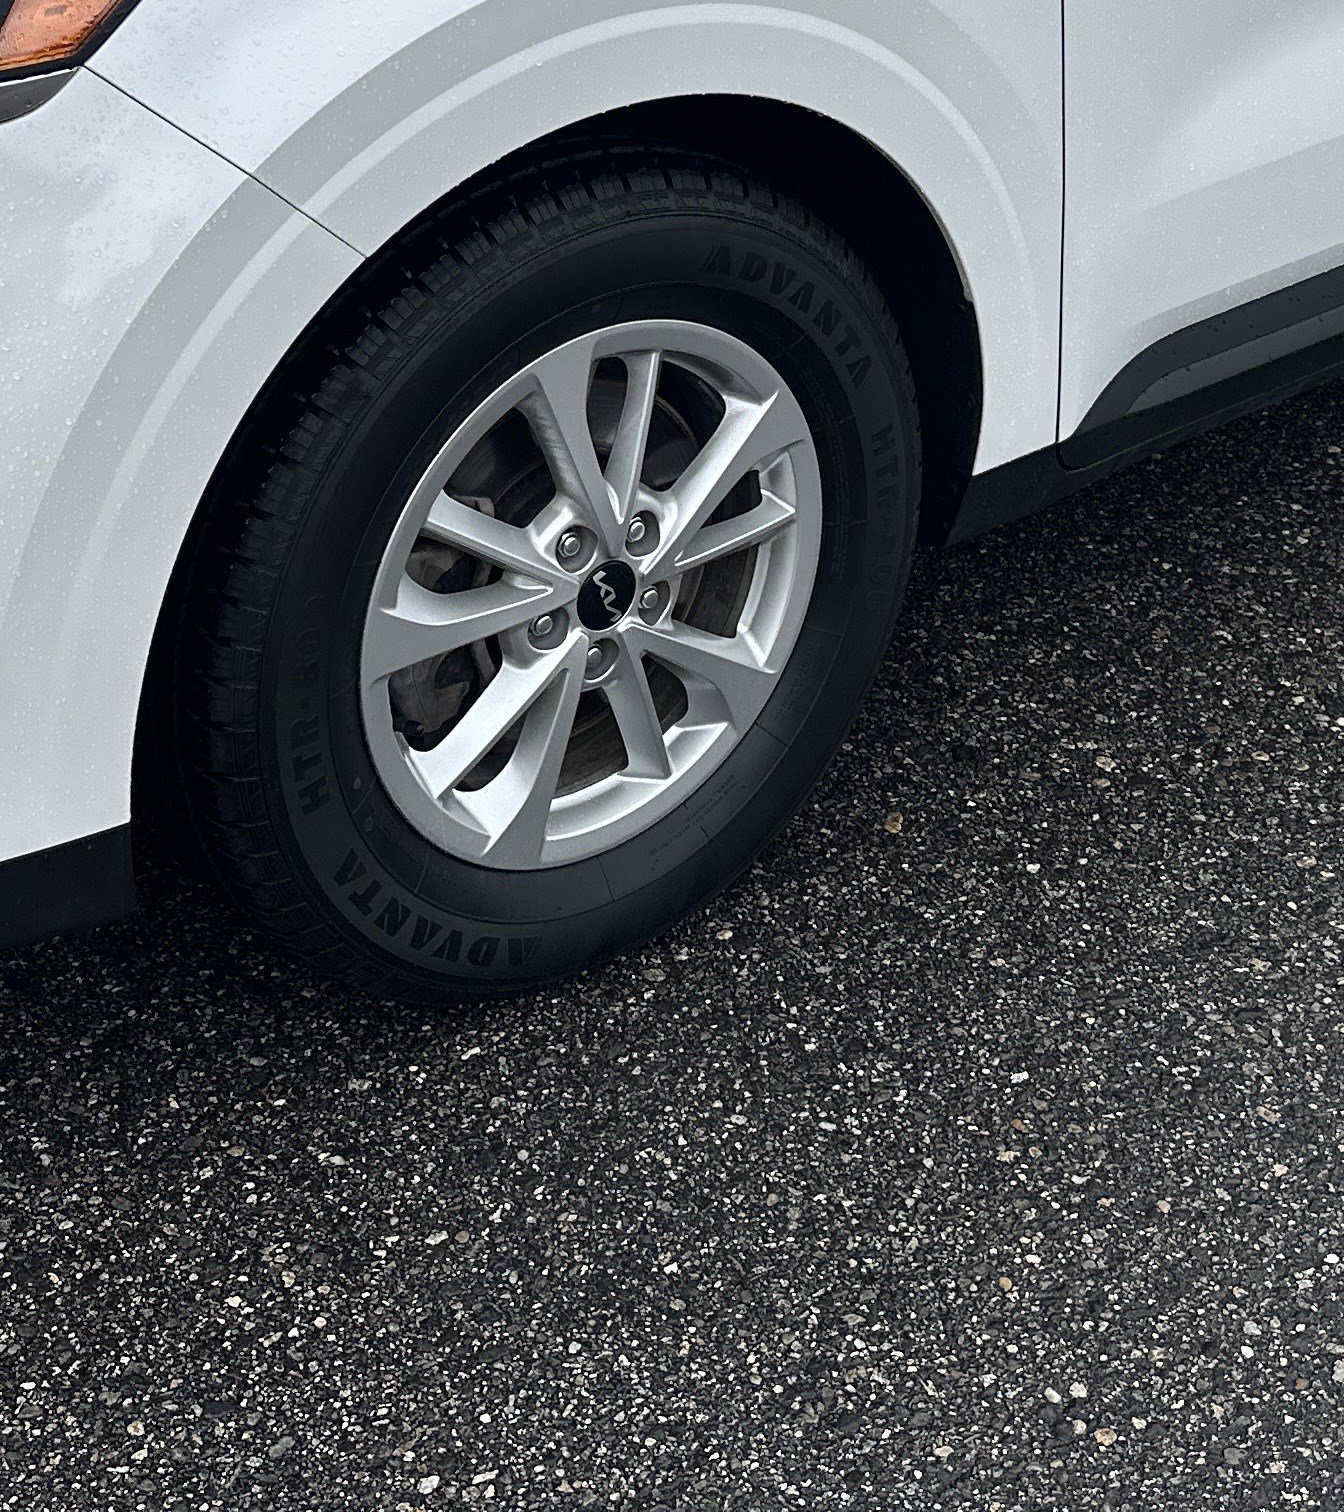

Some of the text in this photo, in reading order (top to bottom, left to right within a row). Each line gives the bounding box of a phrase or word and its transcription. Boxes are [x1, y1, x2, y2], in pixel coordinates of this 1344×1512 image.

[699, 245, 873, 389] ADVANTA
[593, 570, 622, 622] KIA
[332, 847, 543, 967] ADVANTA
